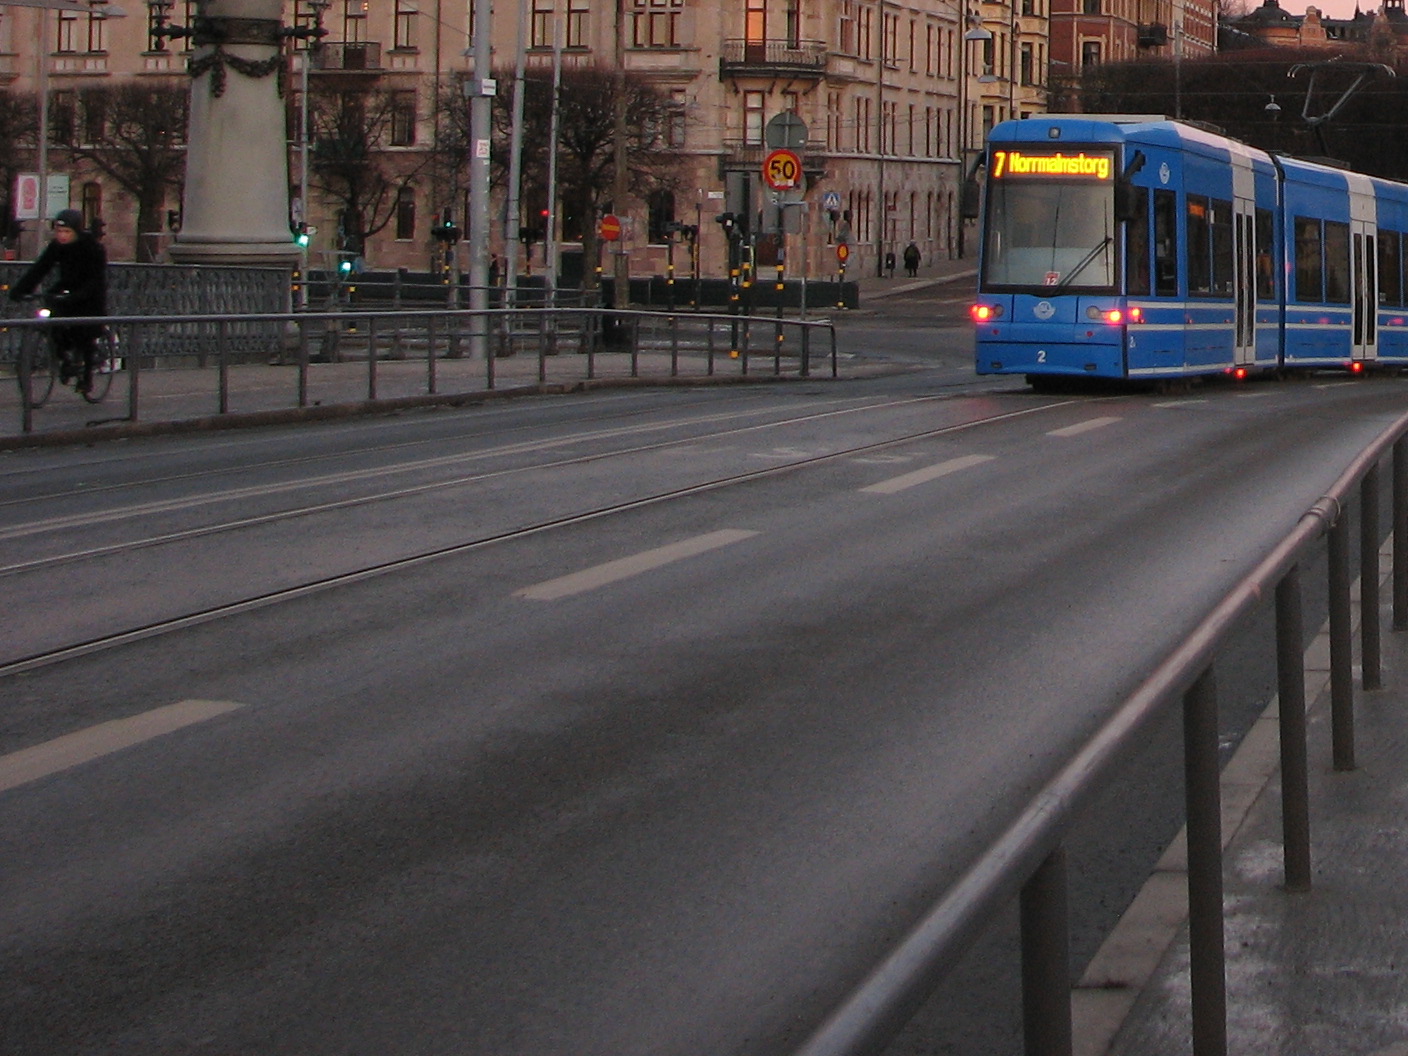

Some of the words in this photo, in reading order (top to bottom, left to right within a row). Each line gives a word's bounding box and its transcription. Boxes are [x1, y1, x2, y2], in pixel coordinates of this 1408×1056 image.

[771, 160, 795, 180] 50
[994, 152, 1006, 177] 7
[1009, 152, 1109, 178] Norrmalmstorg
[1037, 350, 1046, 363] 2
